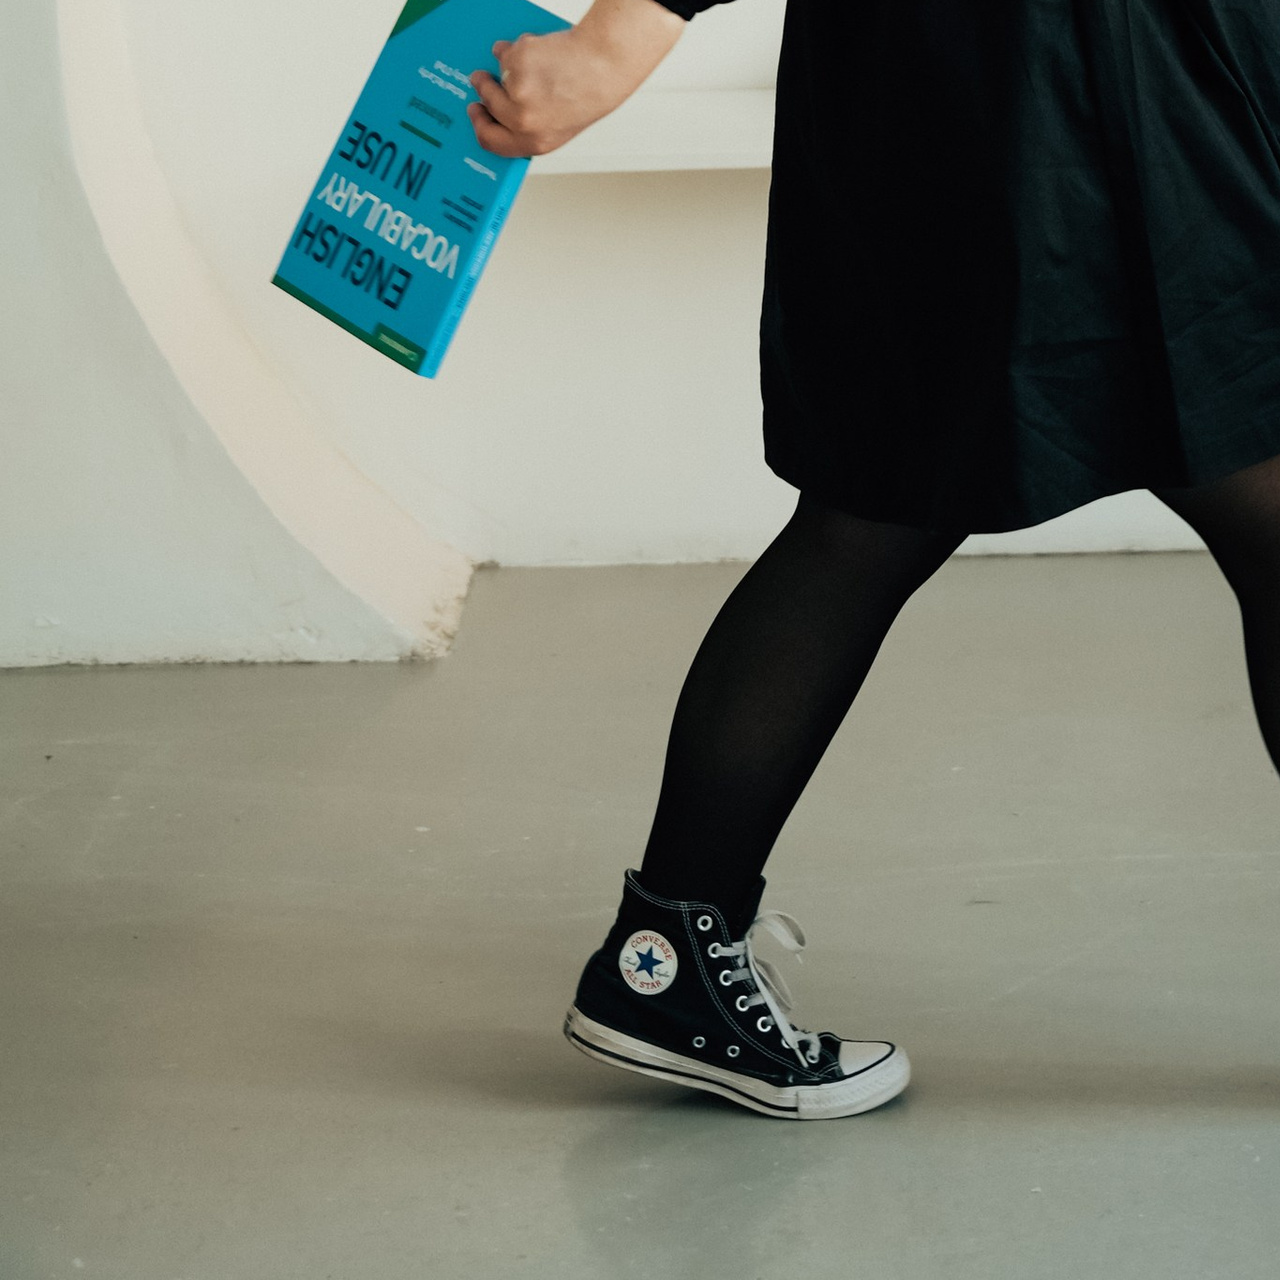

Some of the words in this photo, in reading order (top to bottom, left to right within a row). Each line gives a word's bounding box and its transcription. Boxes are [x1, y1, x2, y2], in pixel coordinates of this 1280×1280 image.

[339, 120, 397, 182] USE
[393, 152, 432, 201] IN
[317, 172, 460, 279] VOCABULARY
[293, 212, 413, 310] ENGLISH
[631, 934, 673, 962] CONVERSE
[625, 969, 638, 985] ALL
[639, 980, 663, 990] STAR
